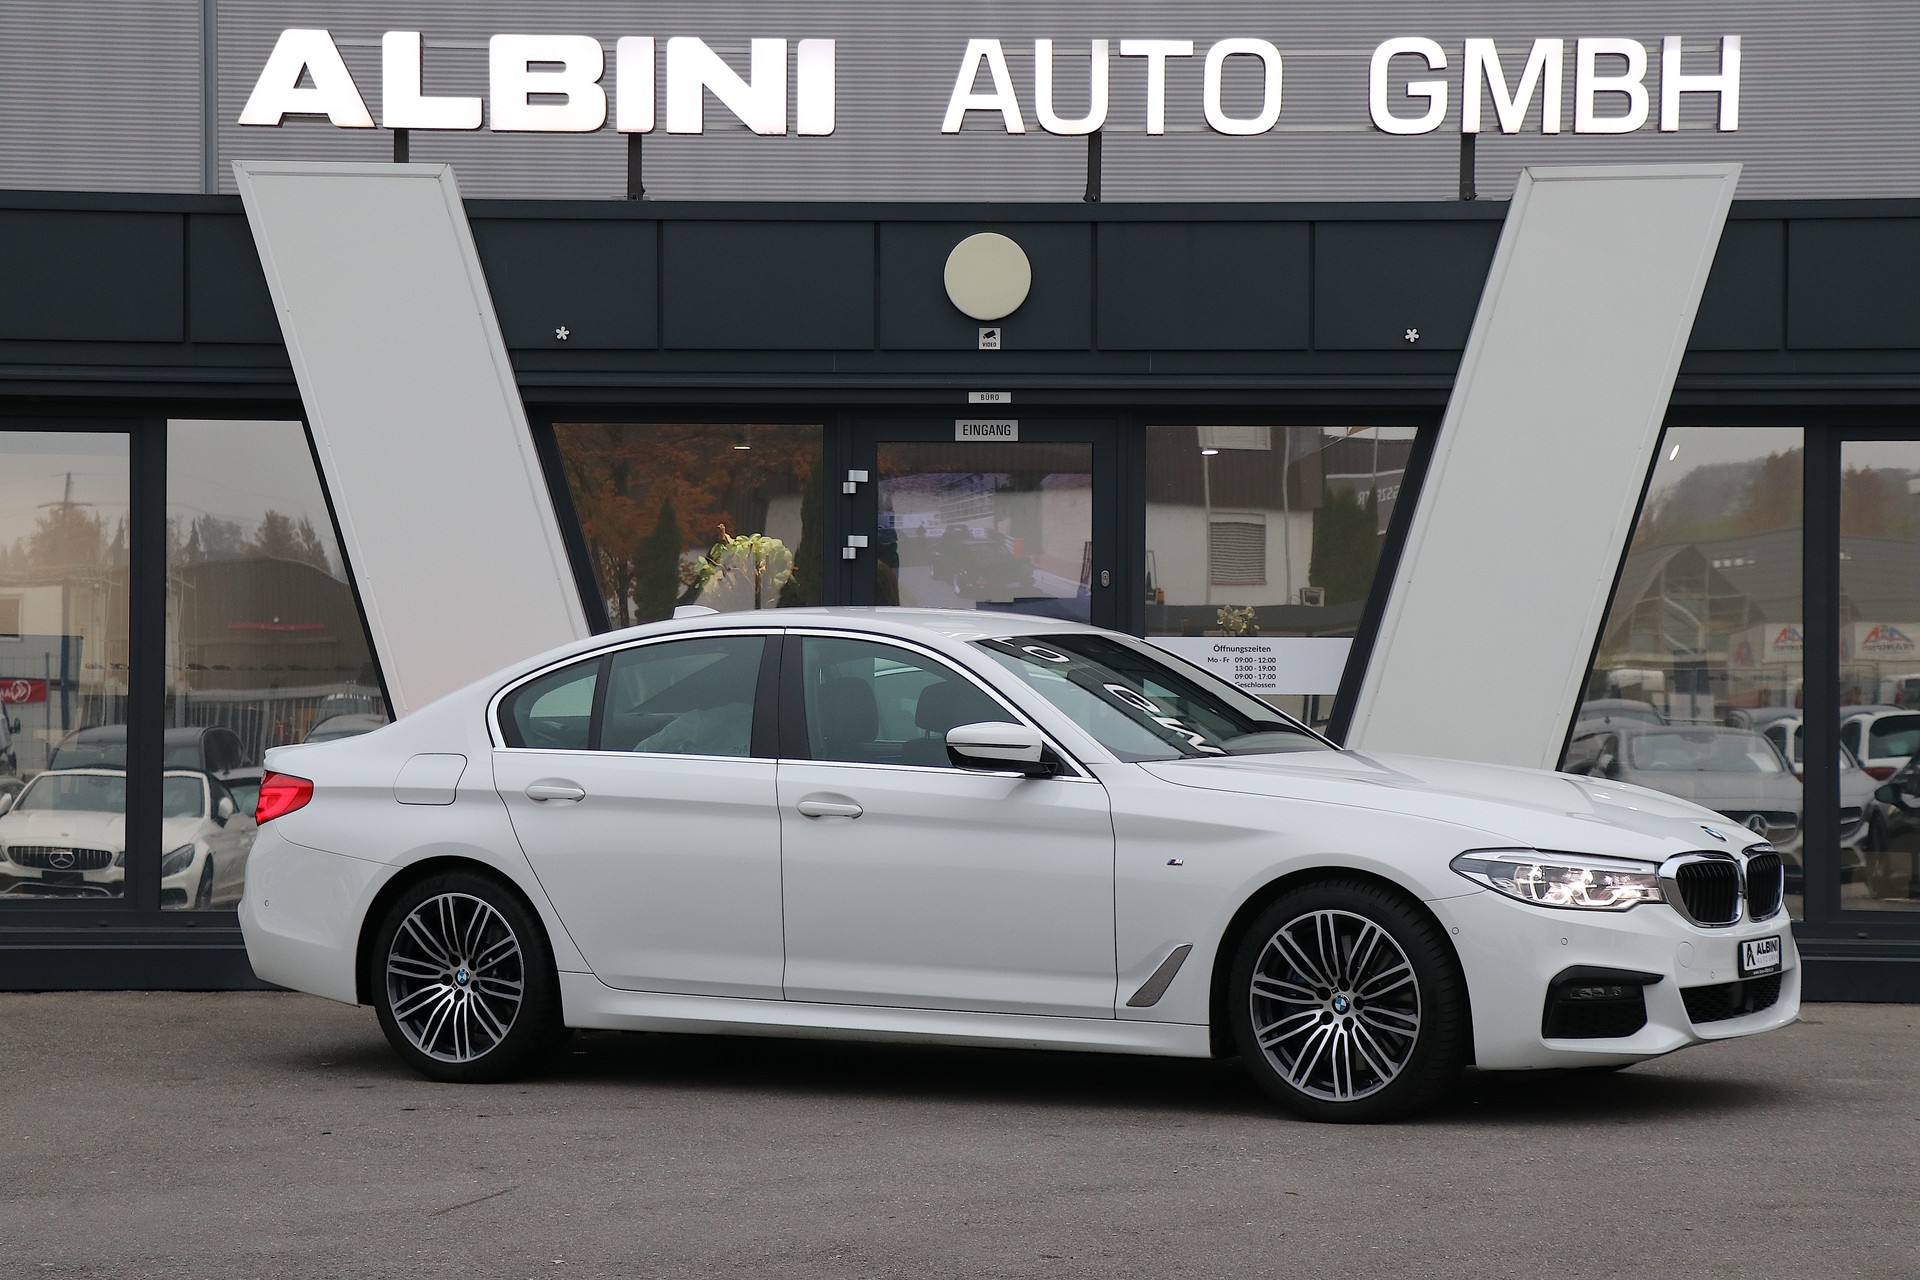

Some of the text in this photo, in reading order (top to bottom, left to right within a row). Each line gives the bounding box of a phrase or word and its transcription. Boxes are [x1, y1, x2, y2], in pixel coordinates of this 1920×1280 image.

[238, 28, 1742, 136] ALBINI AUTO GMBH
[980, 392, 1000, 401] BÜRO
[962, 424, 1011, 436] EINGANG
[1213, 643, 1272, 654] Öffnungszeiten
[1207, 656, 1219, 664] Mo
[1234, 656, 1254, 664] 09:00
[1258, 656, 1277, 664] 12:00
